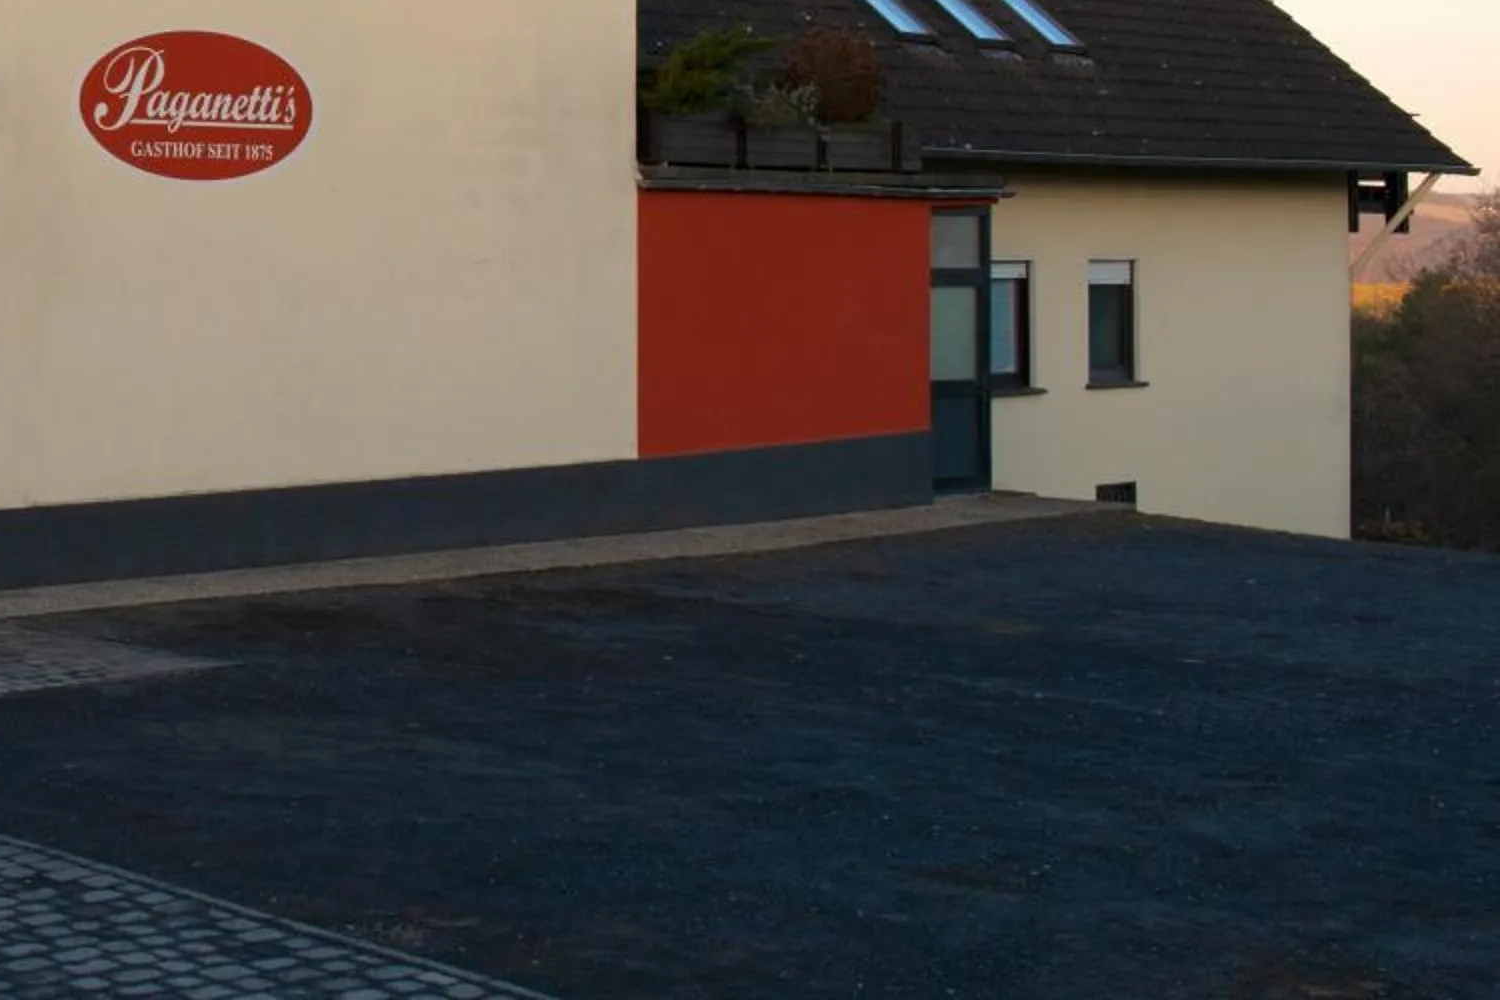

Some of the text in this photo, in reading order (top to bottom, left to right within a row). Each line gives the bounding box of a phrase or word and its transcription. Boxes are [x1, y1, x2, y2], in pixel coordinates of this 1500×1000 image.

[93, 46, 296, 133] Paganetti's
[131, 141, 274, 161] GASTHOF SEIT 1875
